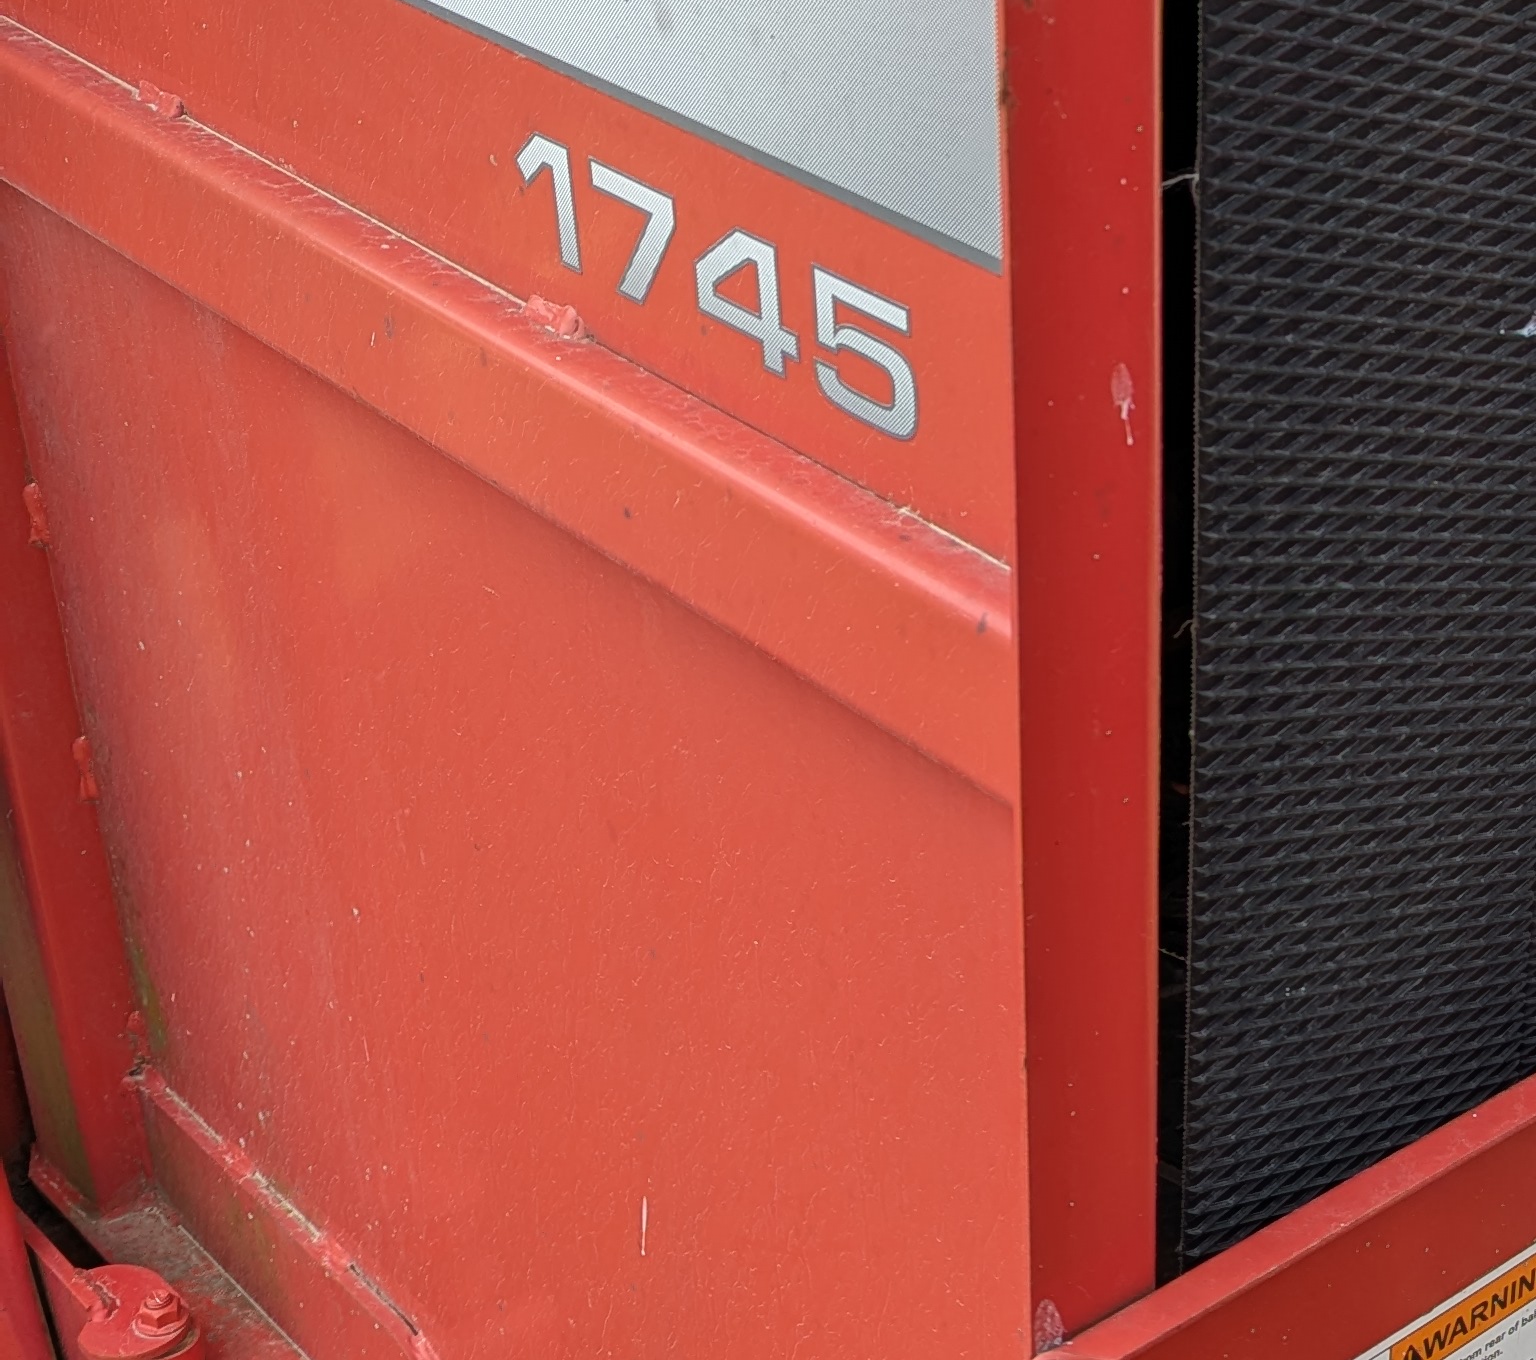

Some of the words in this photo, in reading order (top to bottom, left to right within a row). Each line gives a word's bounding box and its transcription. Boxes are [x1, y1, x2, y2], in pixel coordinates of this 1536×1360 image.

[515, 131, 919, 441] 1745
[1485, 1331, 1506, 1351] rear
[1508, 1319, 1520, 1335] of
